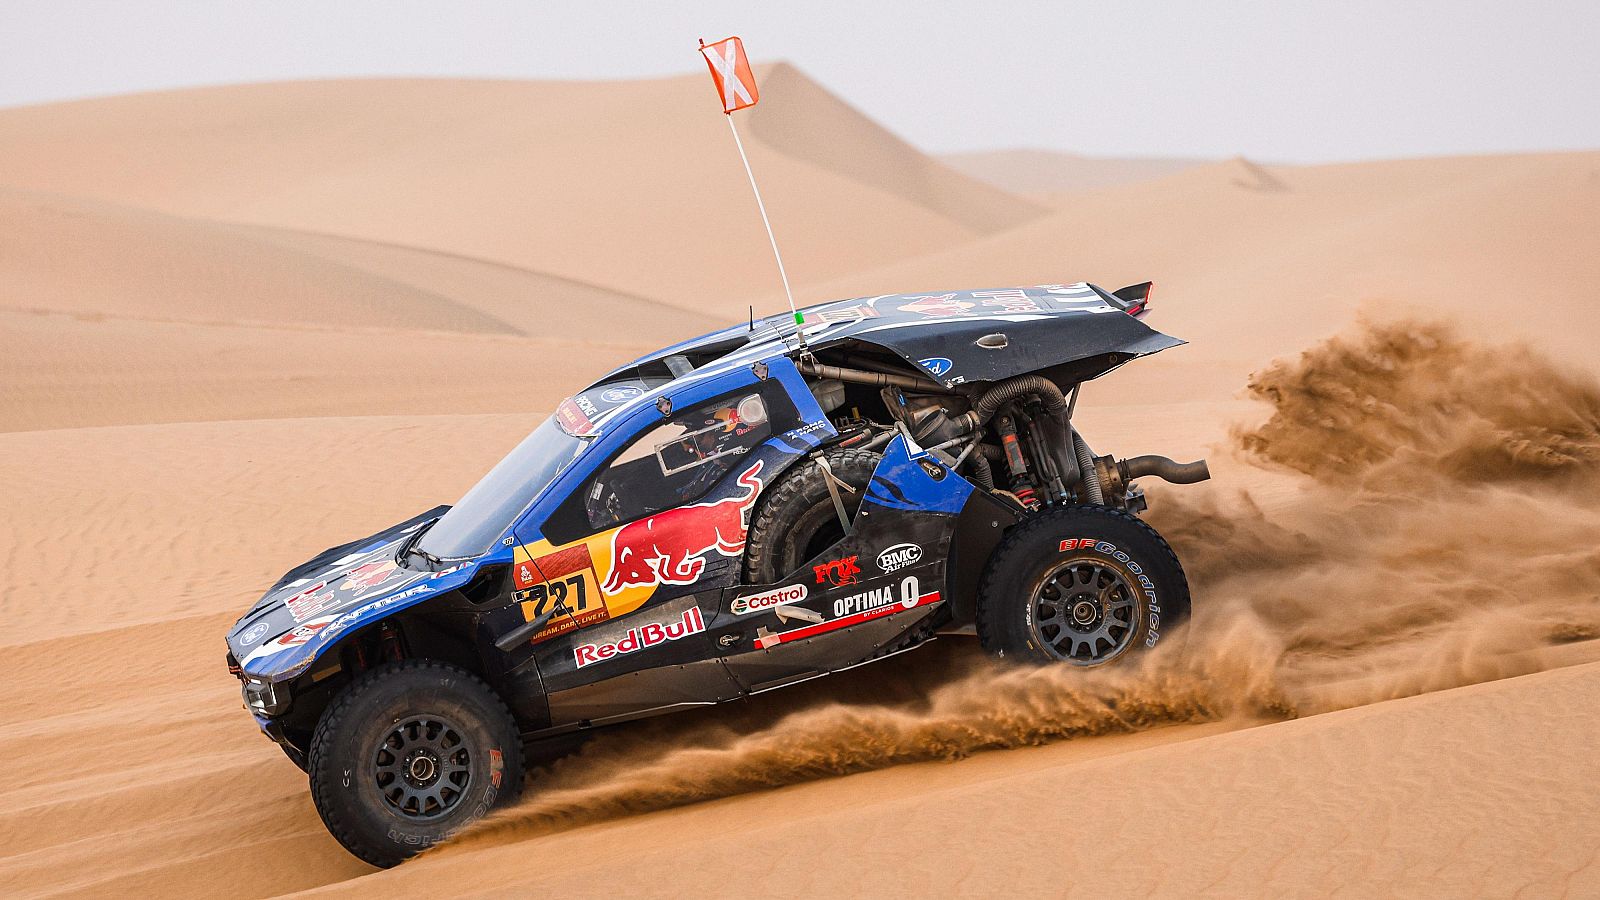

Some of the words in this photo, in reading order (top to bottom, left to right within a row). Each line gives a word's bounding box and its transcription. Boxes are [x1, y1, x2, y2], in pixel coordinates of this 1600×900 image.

[796, 420, 824, 433] ROMA
[800, 423, 826, 436] HARO
[881, 546, 919, 568] BMC
[813, 555, 861, 586] FOX
[884, 563, 902, 574] Air
[749, 586, 803, 609] Castrol
[834, 585, 893, 617] OPTIMA
[1058, 538, 1161, 648] BFGoodrich
[581, 615, 597, 624] LIVE
[872, 605, 895, 615] CLARIOS
[574, 629, 640, 667] Red
[641, 606, 705, 647] Bull
